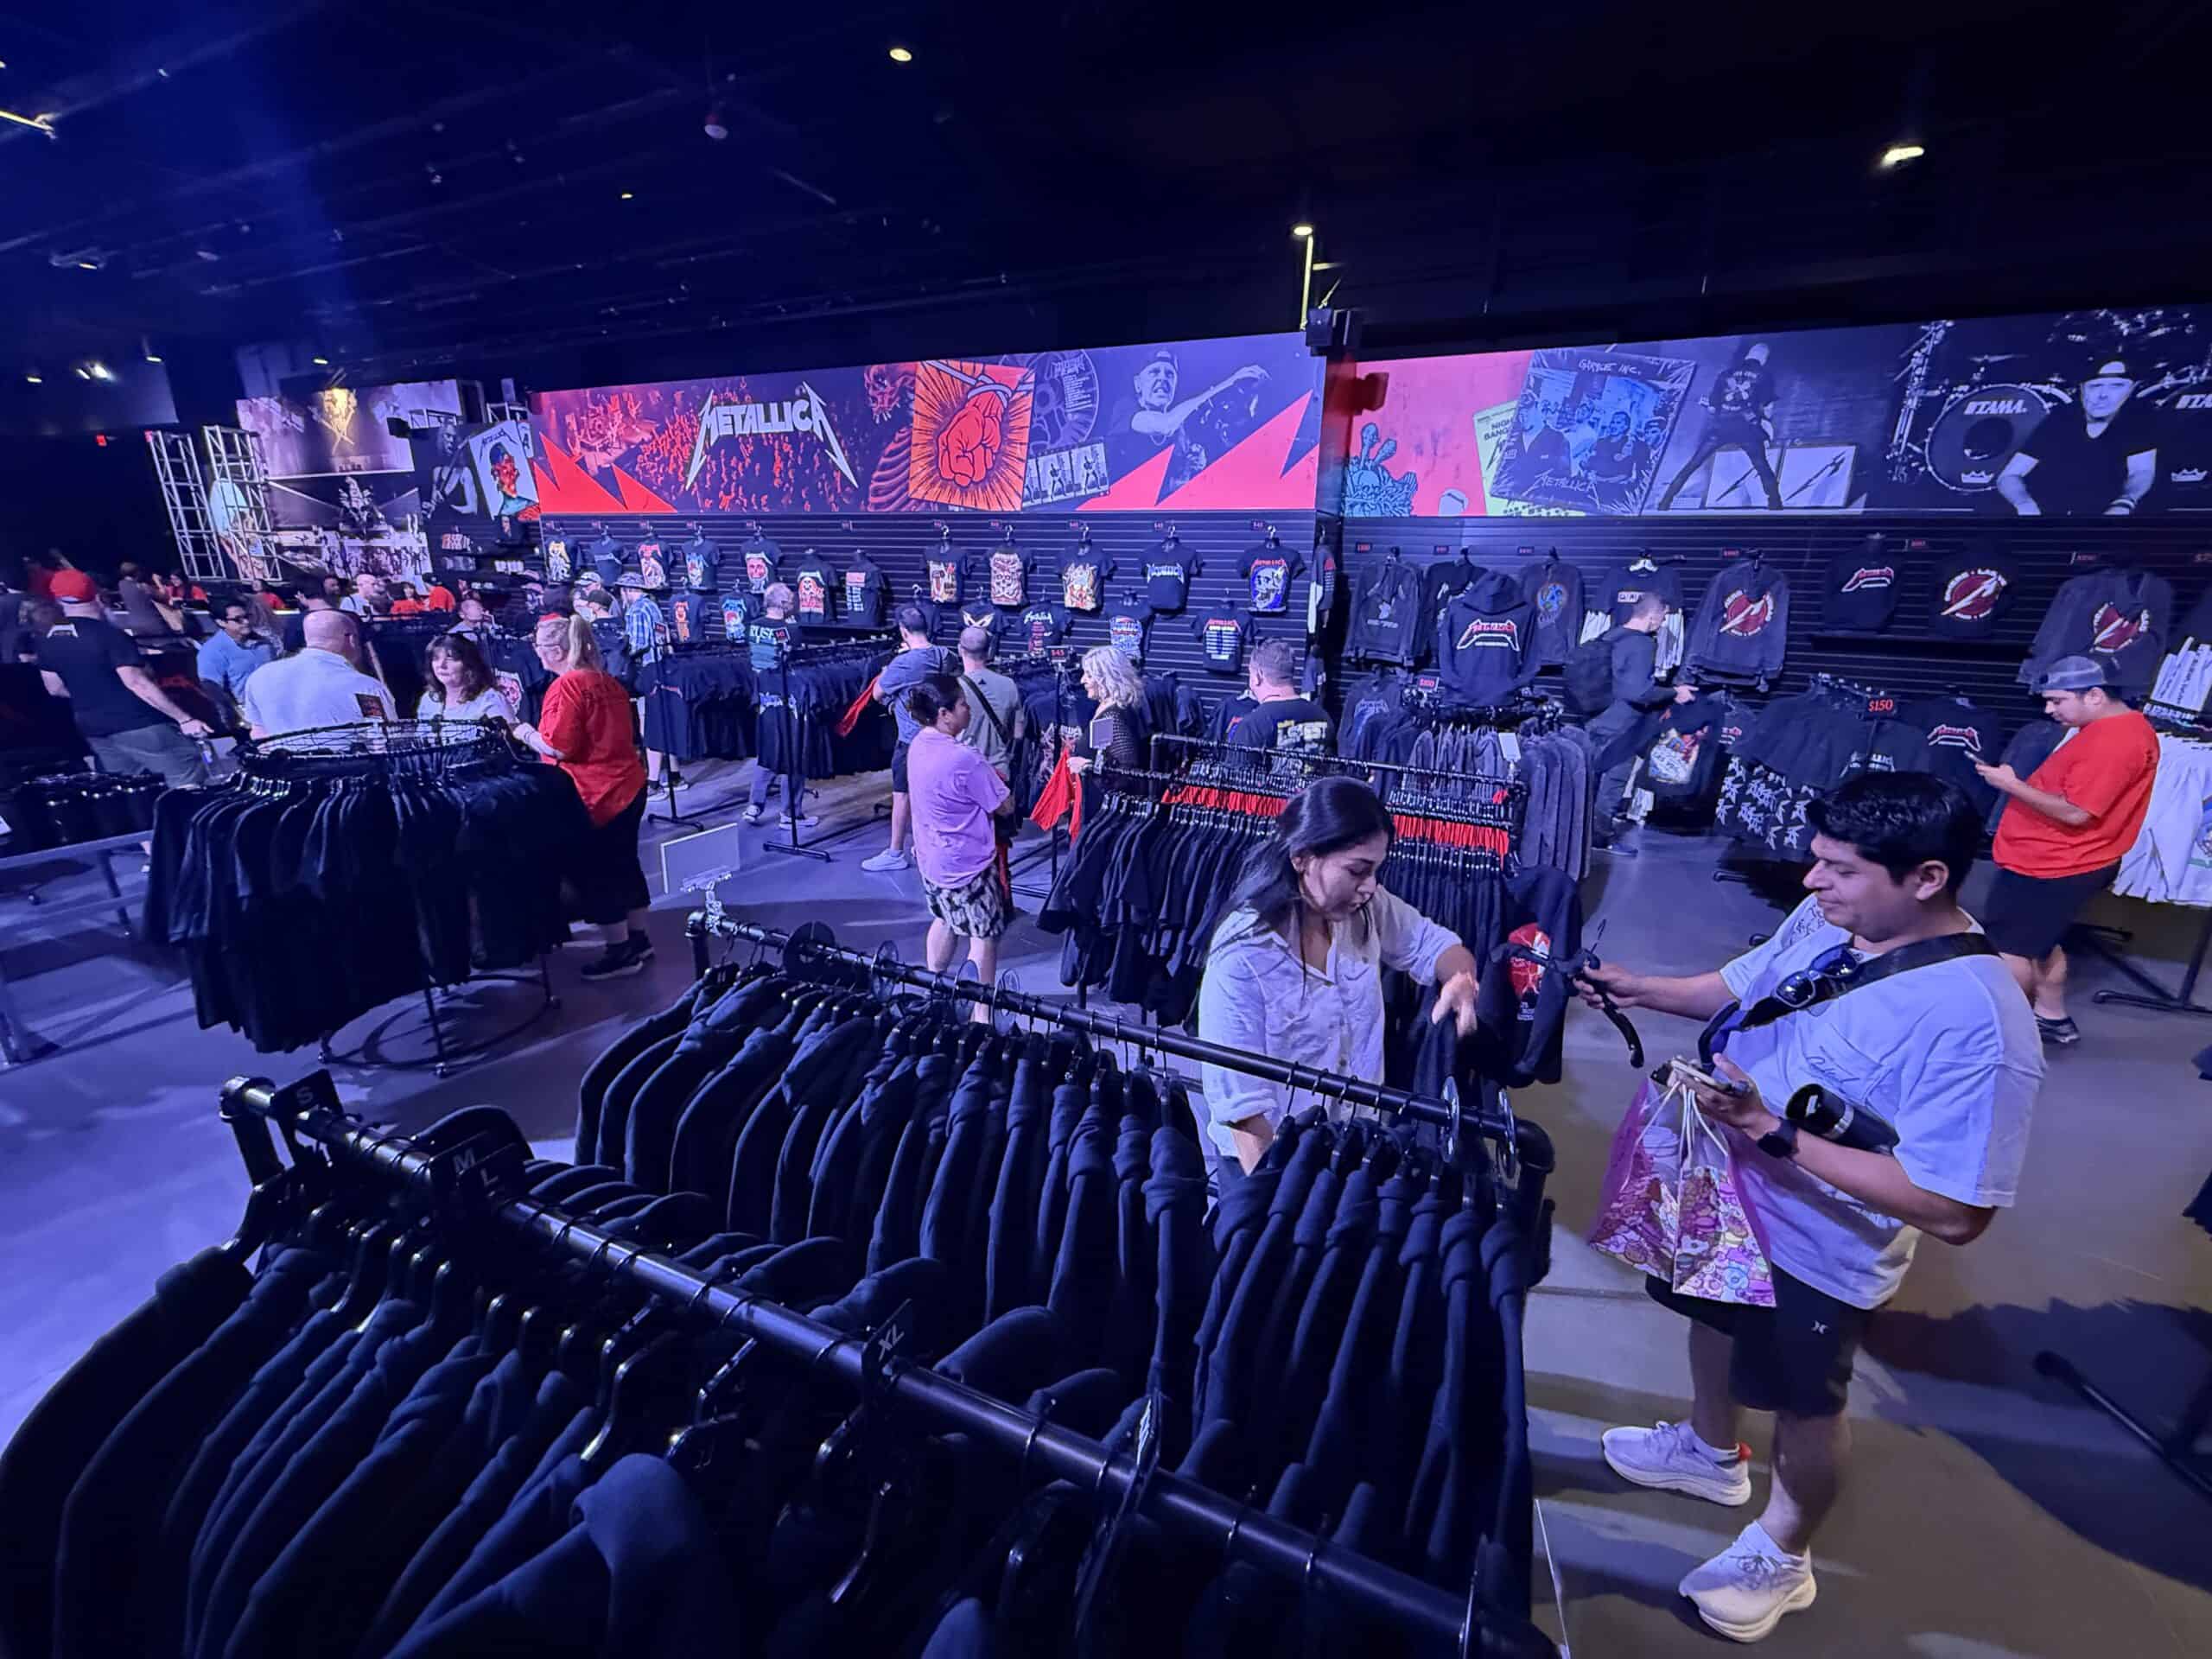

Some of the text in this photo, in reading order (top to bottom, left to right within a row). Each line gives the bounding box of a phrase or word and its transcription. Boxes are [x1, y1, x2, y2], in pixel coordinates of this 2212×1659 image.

[686, 381, 859, 491] METALLICA
[1522, 469, 1602, 510] METALLICA
[1867, 698, 1894, 713] $150
[296, 1085, 315, 1106] S
[452, 1147, 477, 1173] M
[480, 1167, 499, 1188] L
[877, 1322, 906, 1363] XL
